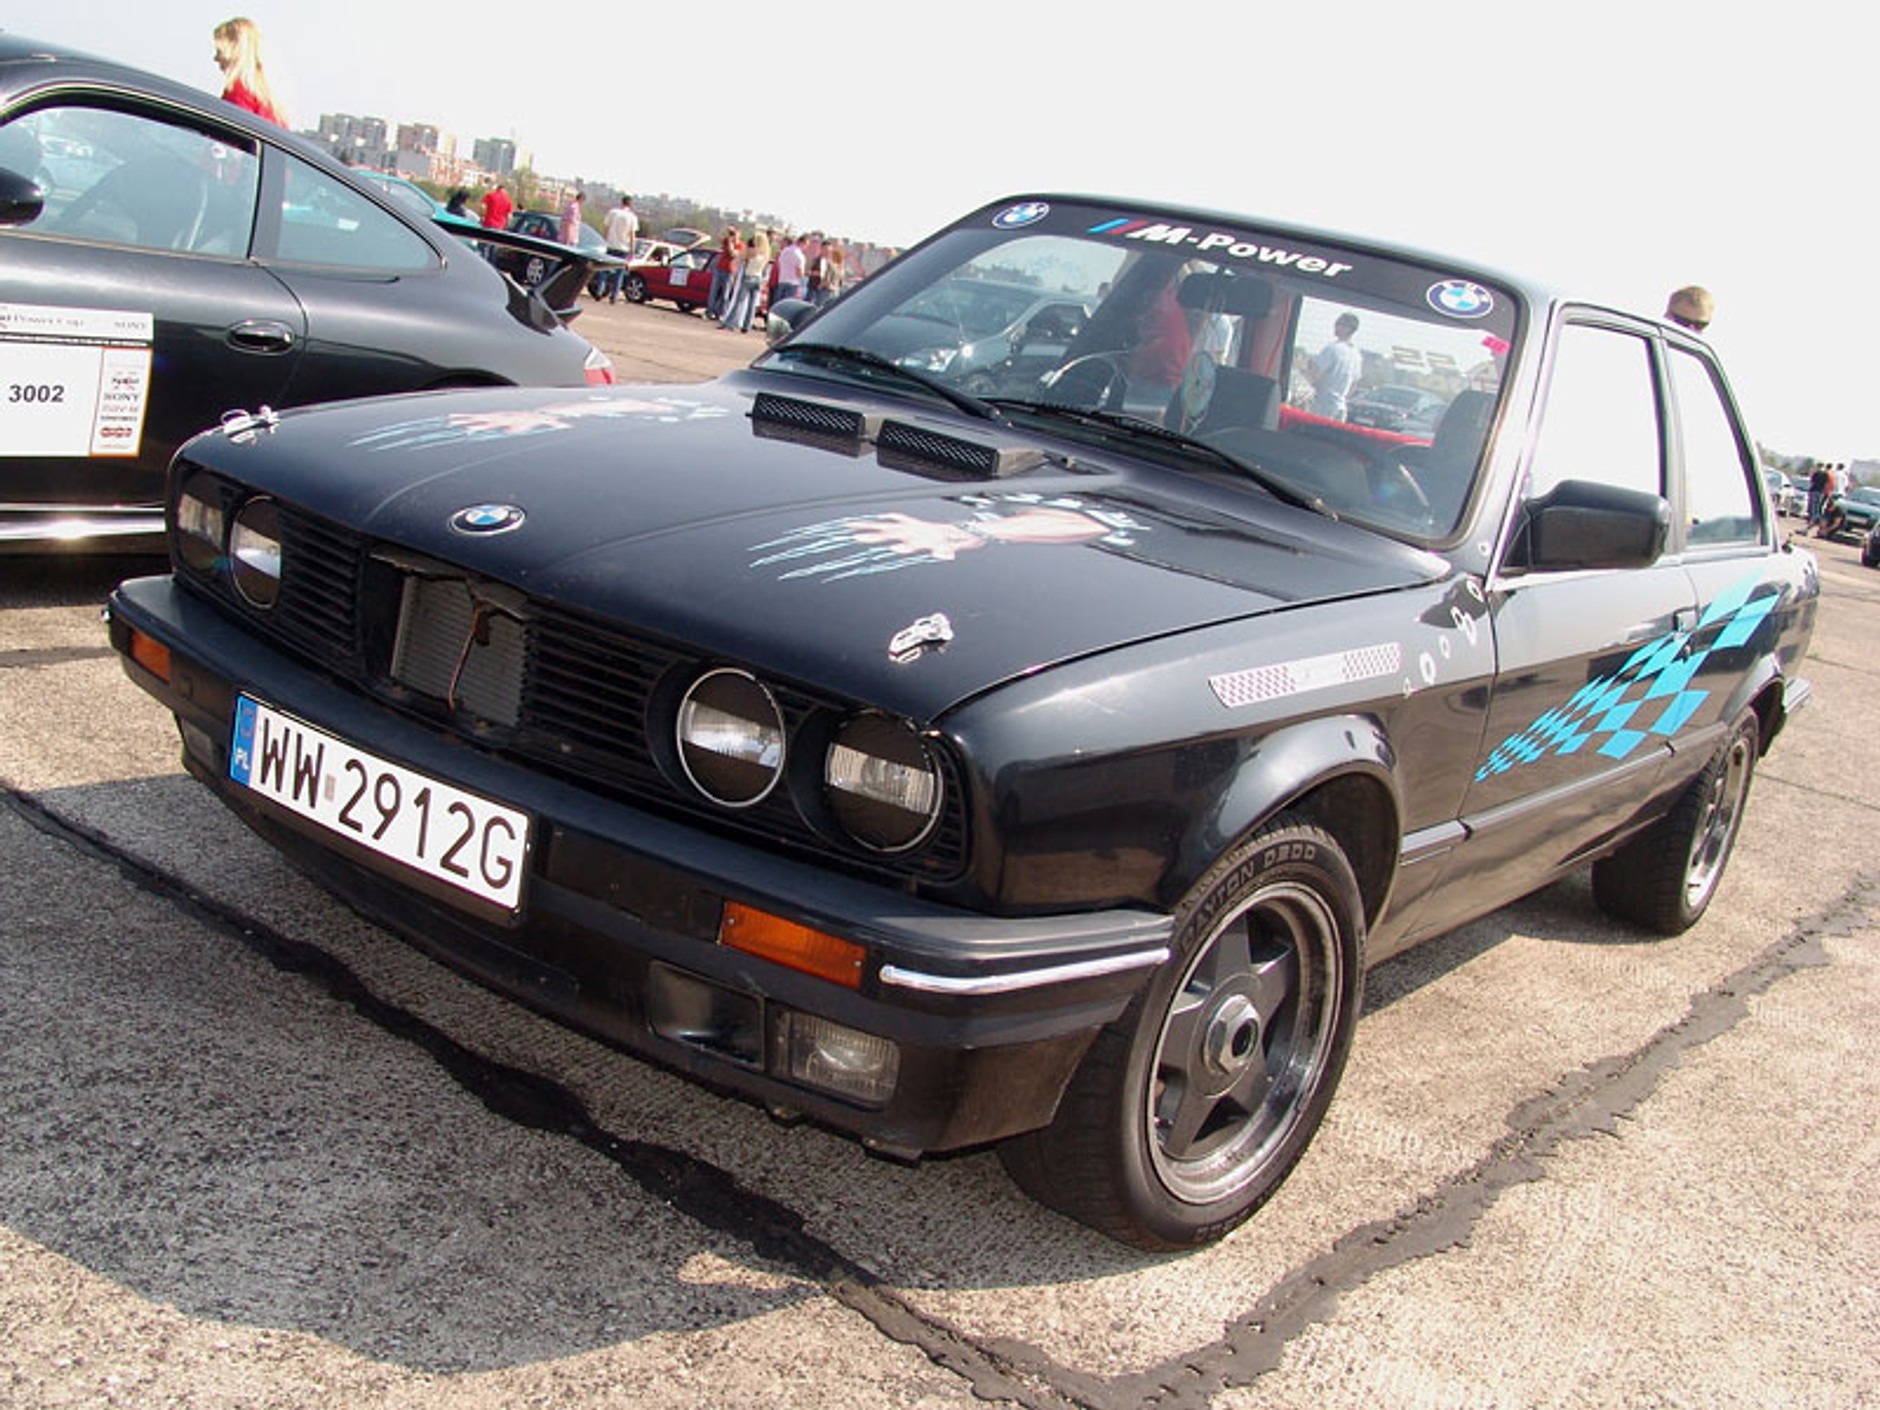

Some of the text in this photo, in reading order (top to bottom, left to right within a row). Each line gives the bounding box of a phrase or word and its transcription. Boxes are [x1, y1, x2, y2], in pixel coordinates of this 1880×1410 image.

[1125, 223, 1353, 277] M-Power
[9, 384, 65, 403] 3002
[235, 747, 249, 770] PL
[260, 718, 516, 889] WW 2912G
